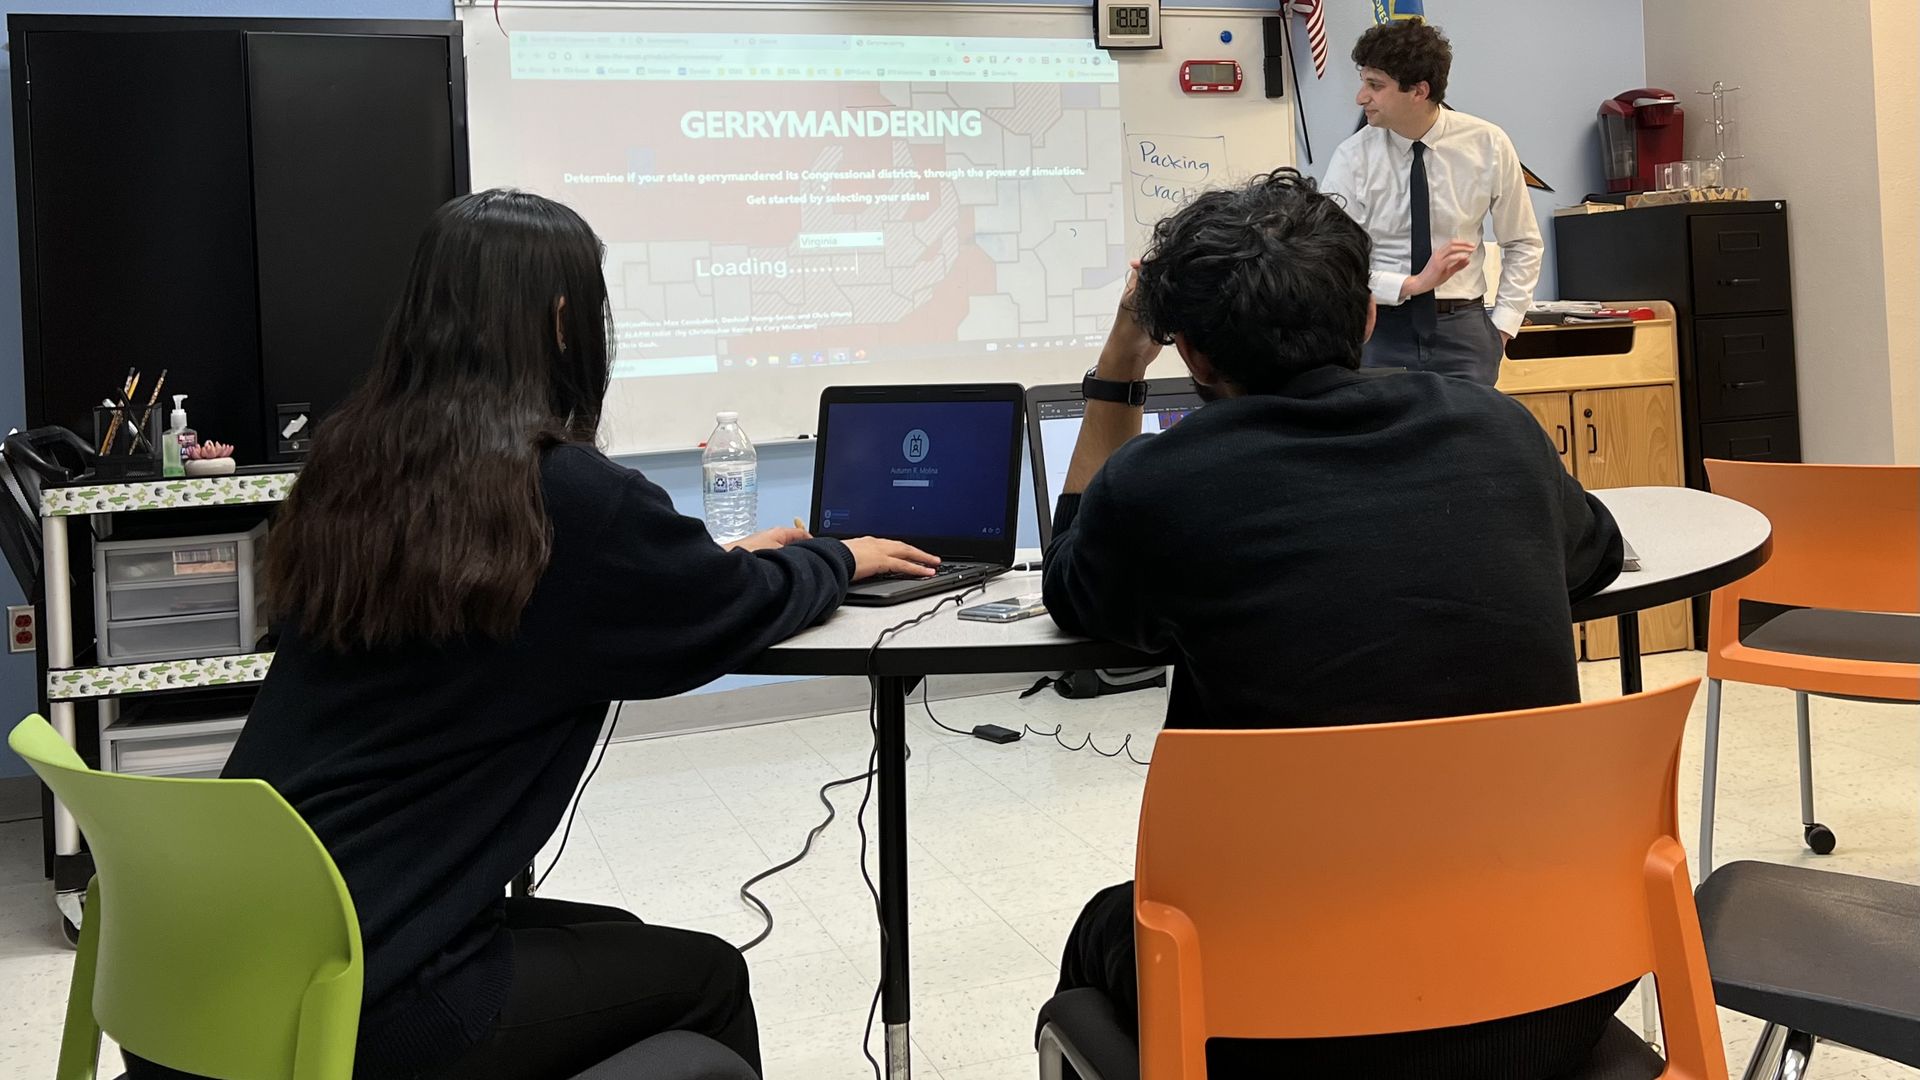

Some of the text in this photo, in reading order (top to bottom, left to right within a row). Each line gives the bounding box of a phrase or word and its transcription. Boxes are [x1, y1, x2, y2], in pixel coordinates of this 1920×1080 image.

[681, 110, 983, 138] GERRYMANDERING
[1139, 141, 1210, 182] Packing
[564, 166, 1085, 185] Determine if your state gerrymandered its Congressional districts, through the power of simulation.
[746, 191, 930, 206] Get started by selecting your state!
[801, 237, 838, 247] Virginia
